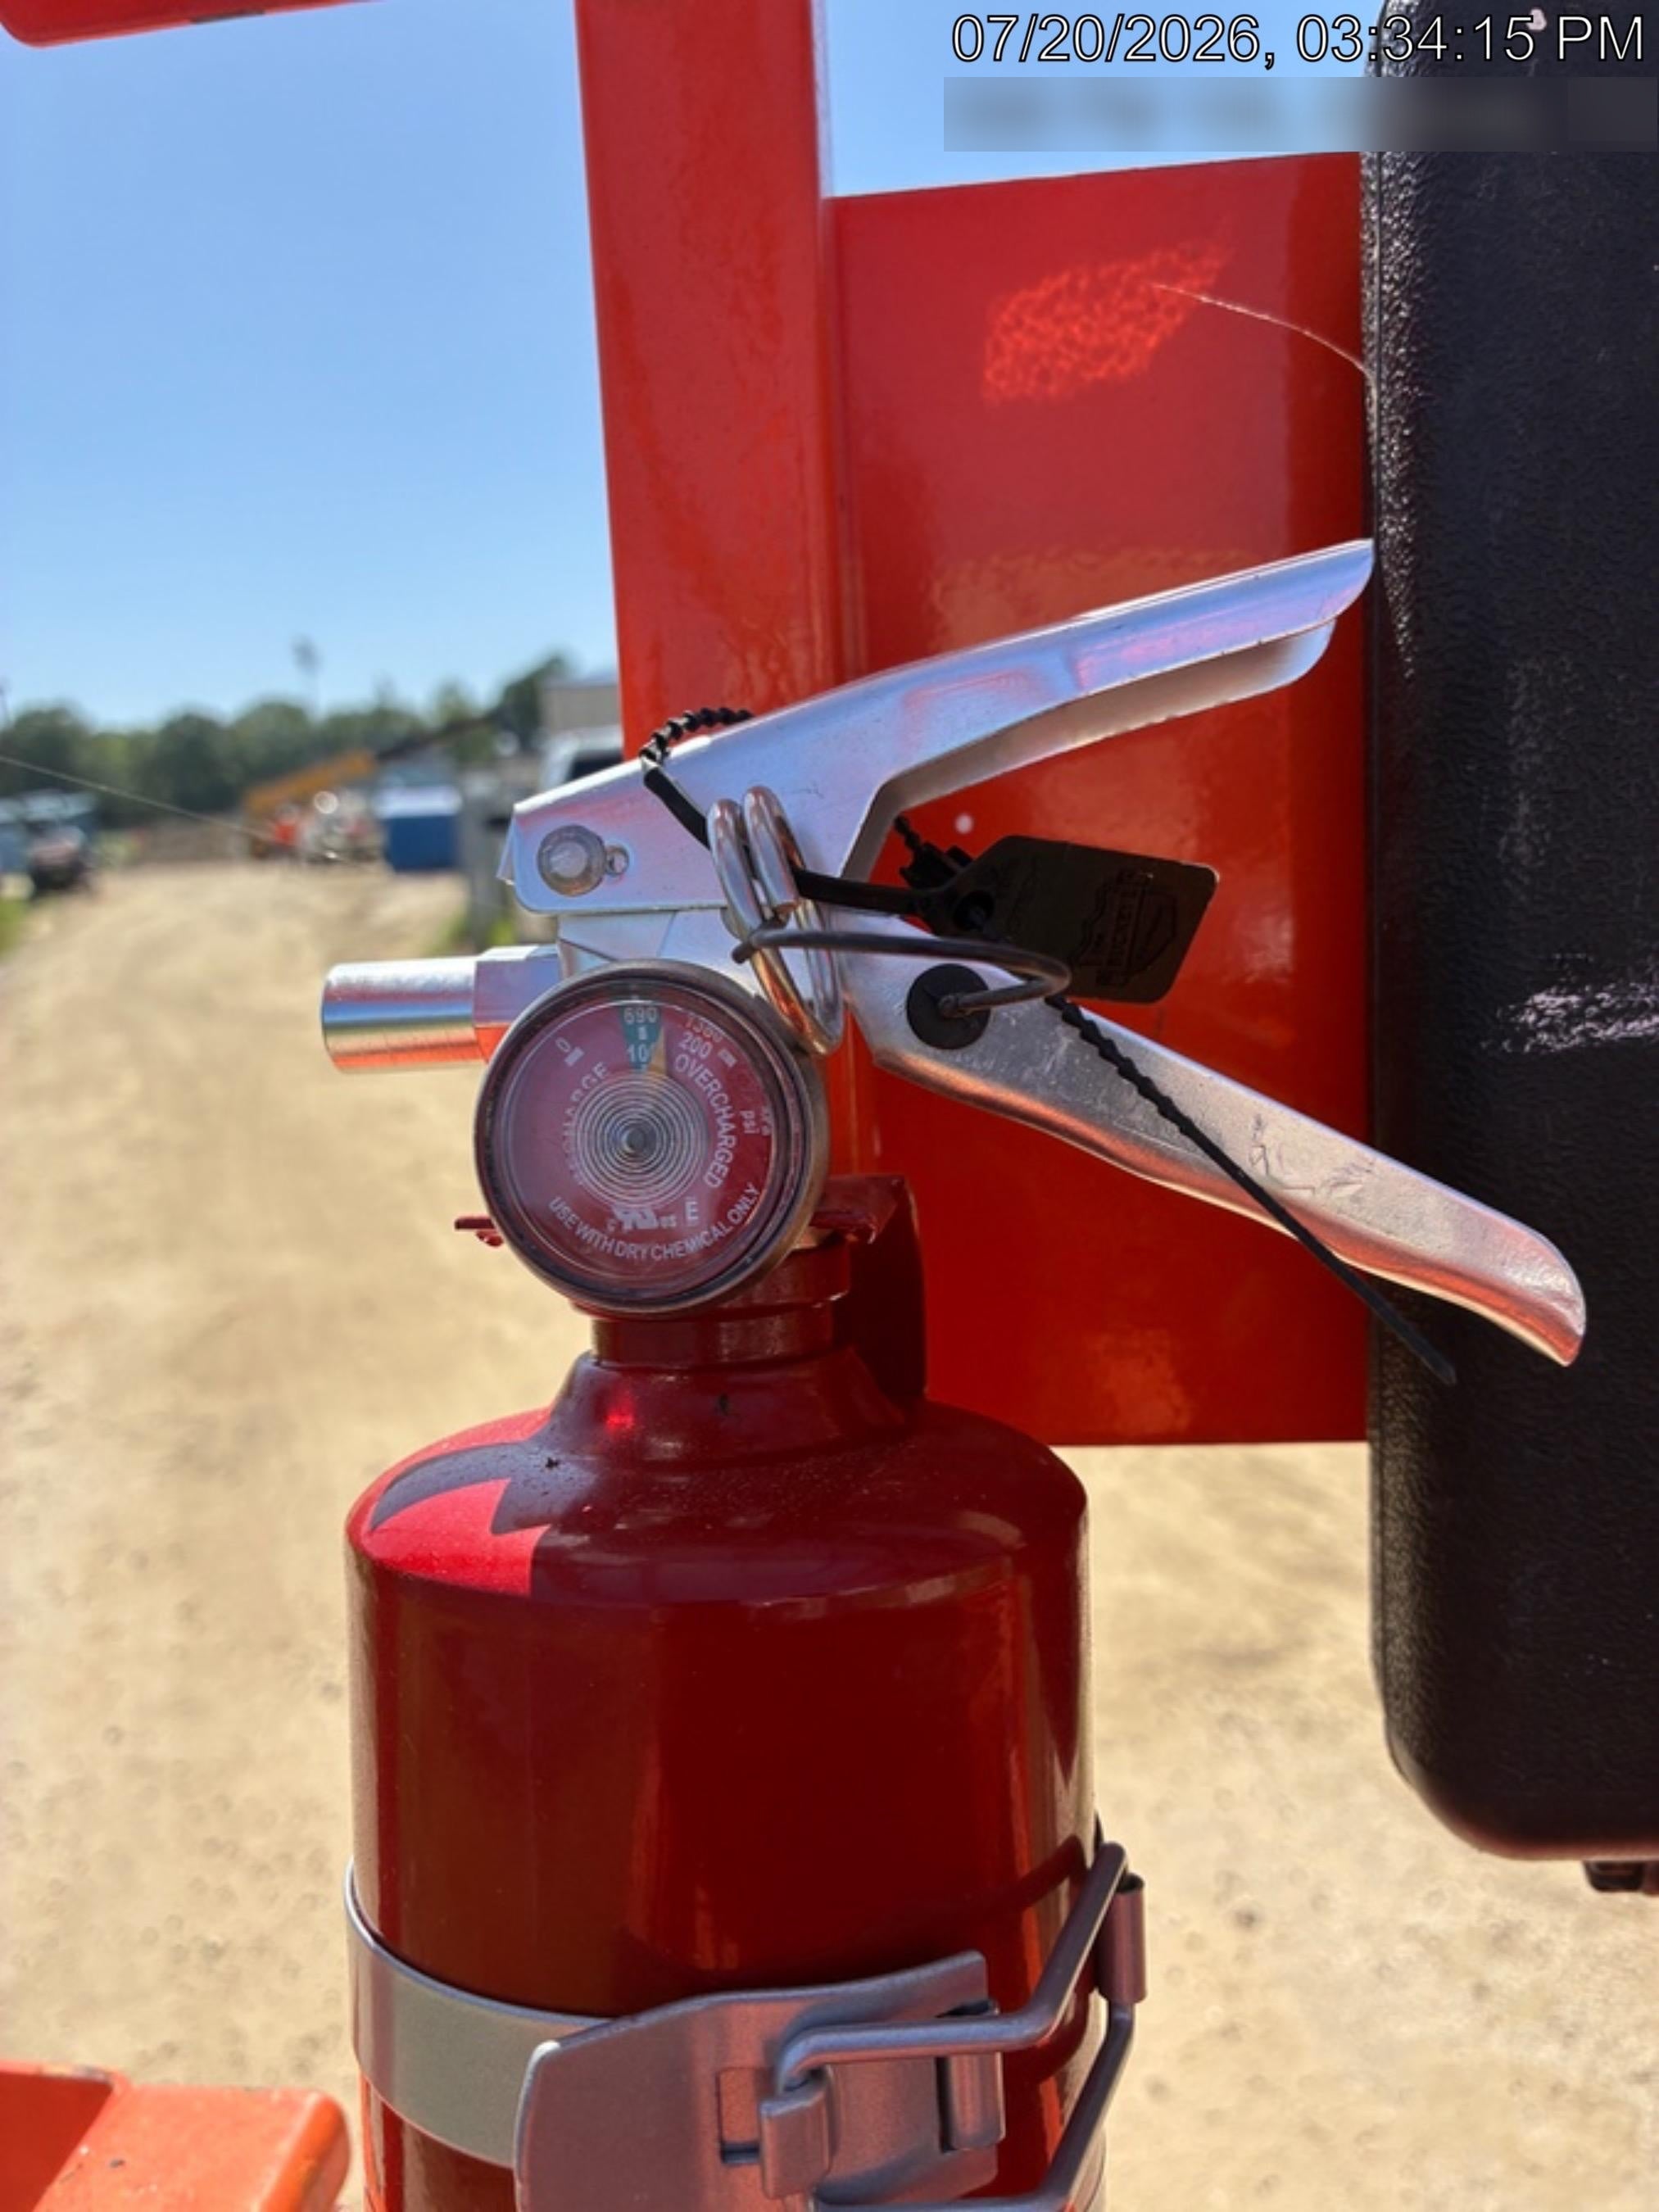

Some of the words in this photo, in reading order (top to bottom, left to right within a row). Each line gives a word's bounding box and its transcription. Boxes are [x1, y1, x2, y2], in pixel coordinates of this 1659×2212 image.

[678, 1031, 713, 1058] 200
[675, 1054, 737, 1188] OVERCHARGED
[548, 1195, 576, 1229] USE
[576, 1222, 614, 1253] WITH
[614, 1240, 647, 1259] DRY
[650, 1220, 733, 1261] CHEMICAL
[727, 1181, 762, 1226] ONLY
